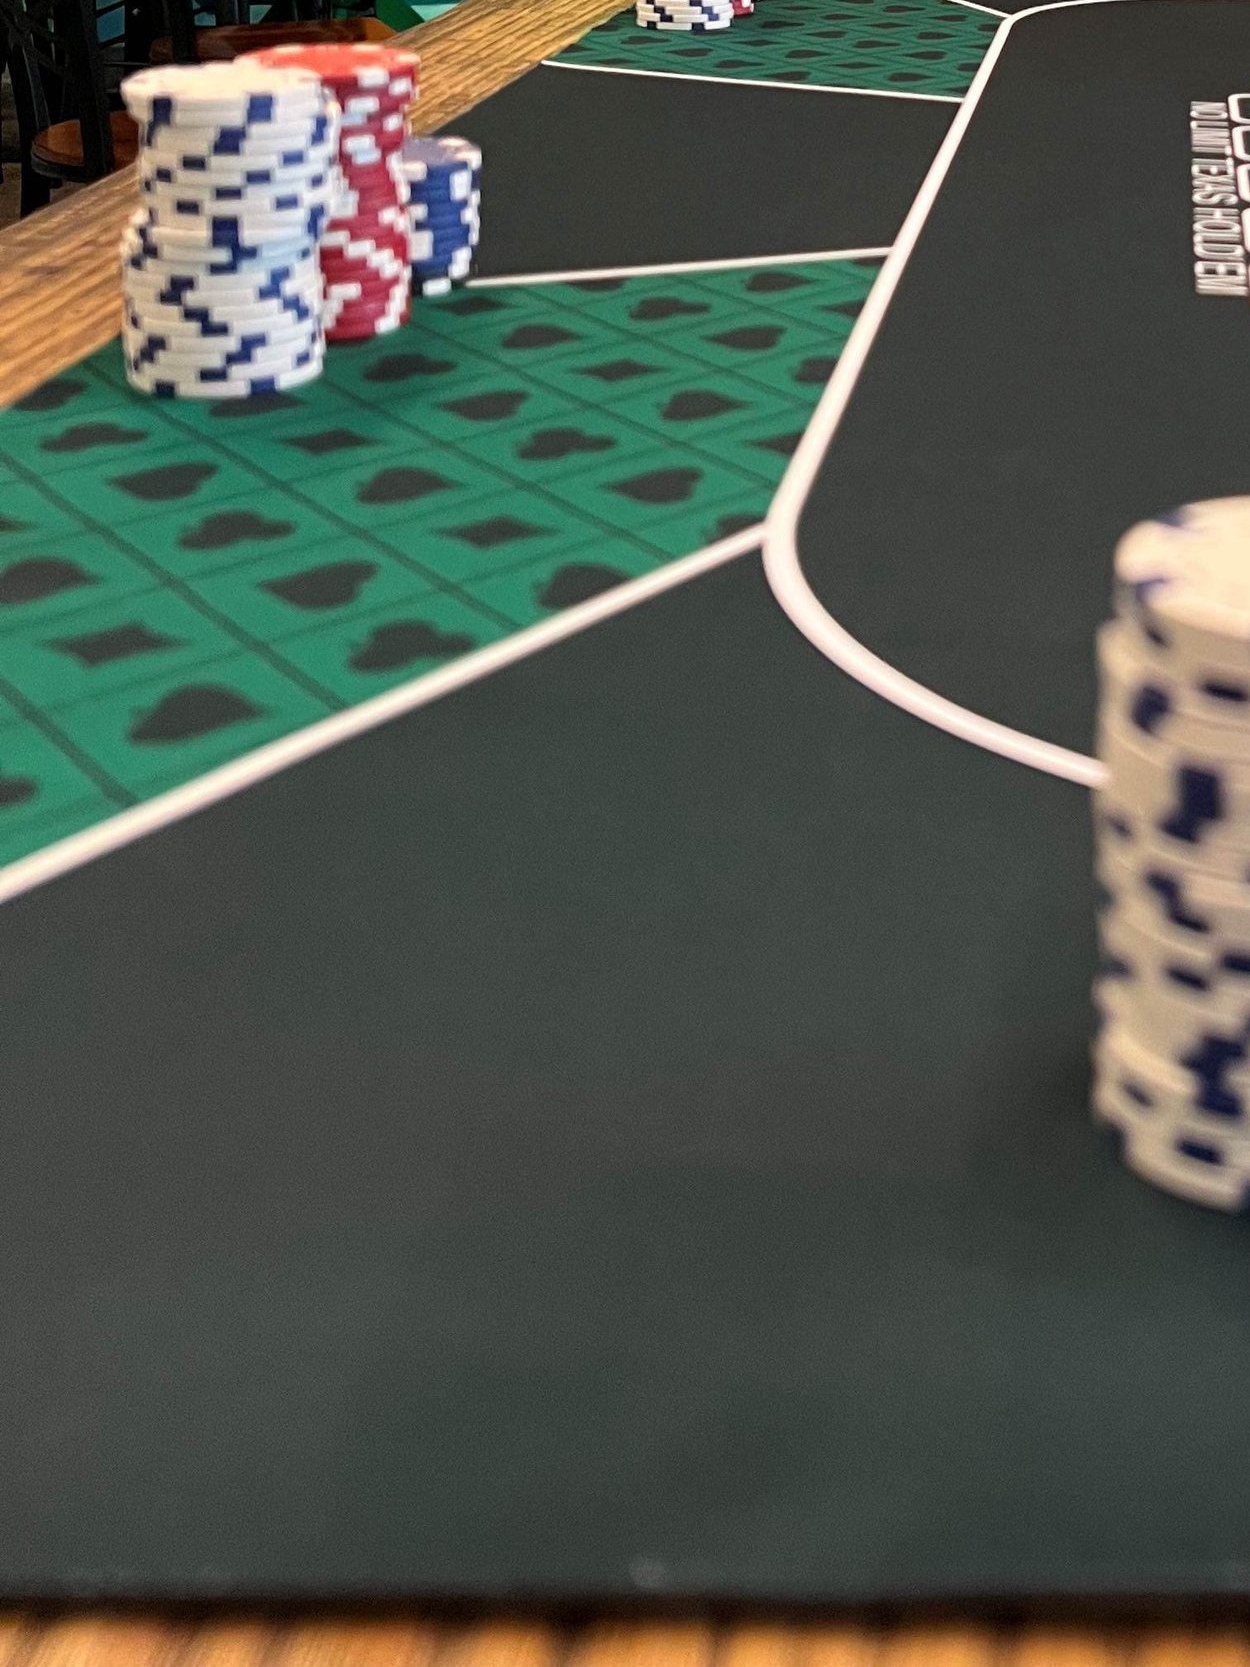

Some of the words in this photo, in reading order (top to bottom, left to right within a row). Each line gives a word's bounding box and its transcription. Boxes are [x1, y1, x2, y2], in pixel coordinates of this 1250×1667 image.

[1190, 101, 1228, 120] NO
[1190, 120, 1232, 156] LIMIT
[1191, 157, 1239, 205] TEXAS
